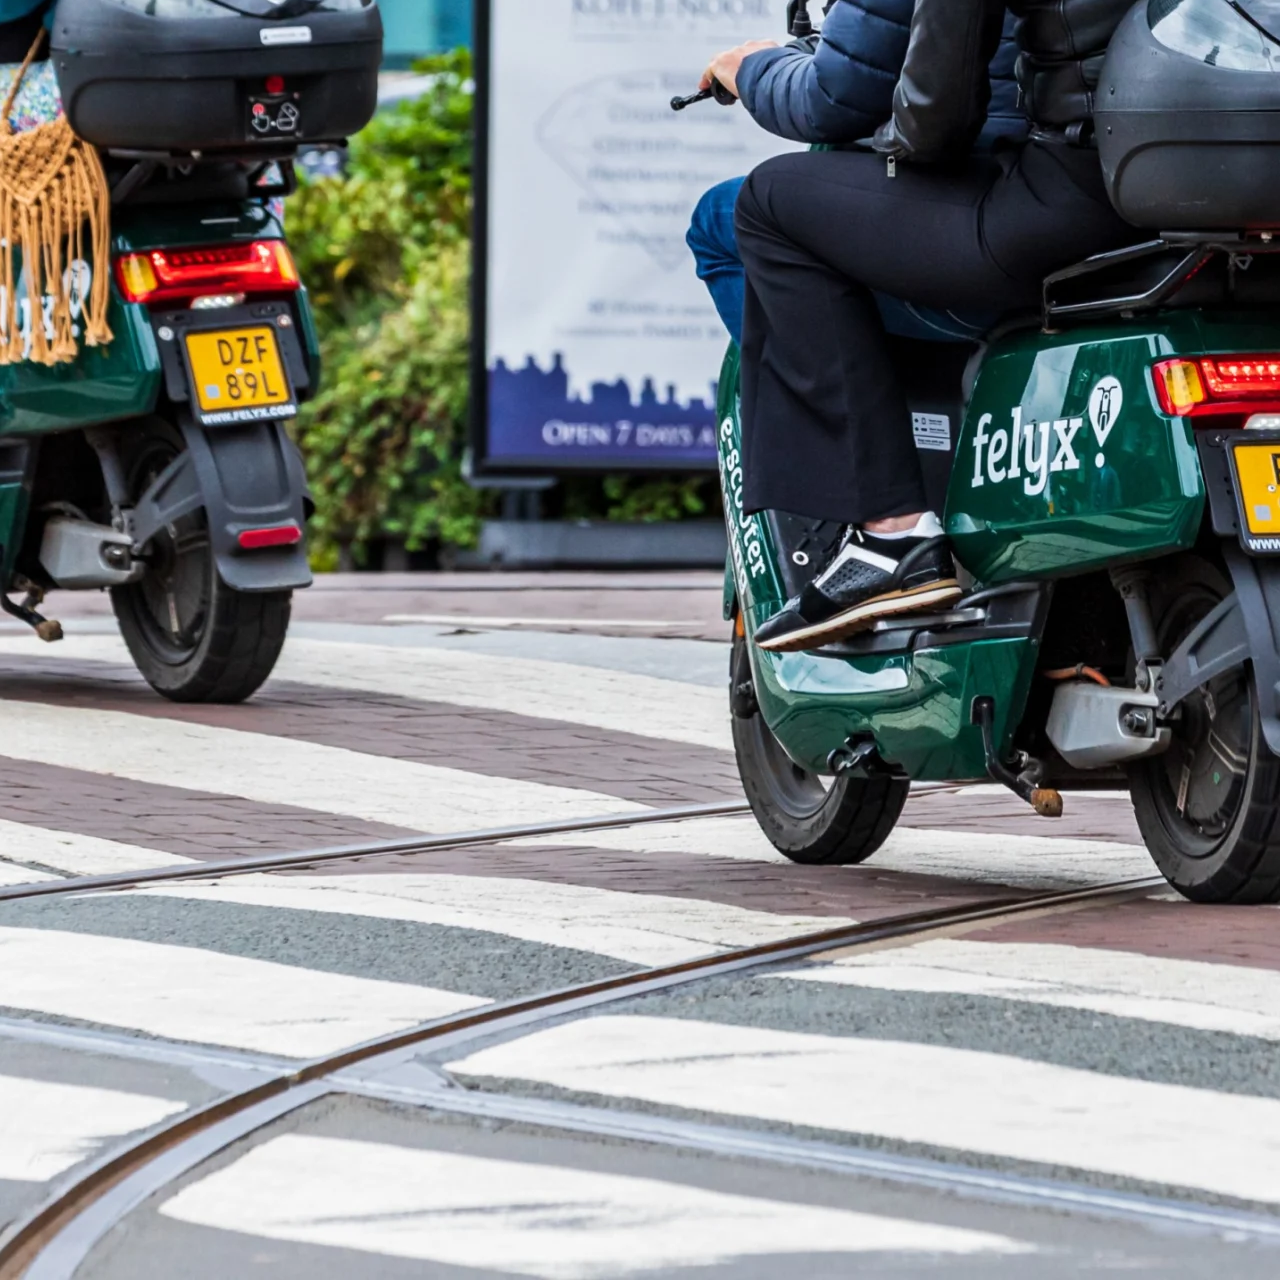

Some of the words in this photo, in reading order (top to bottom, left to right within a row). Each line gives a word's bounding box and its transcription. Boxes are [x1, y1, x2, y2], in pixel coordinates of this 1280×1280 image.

[217, 335, 267, 366] DZF
[226, 370, 278, 401] 89L
[201, 404, 297, 425] WWW.FELYX.COM
[542, 419, 612, 446] OPEN
[615, 419, 633, 446] 7
[636, 422, 693, 447] DAYS
[971, 406, 1084, 496] felyx
